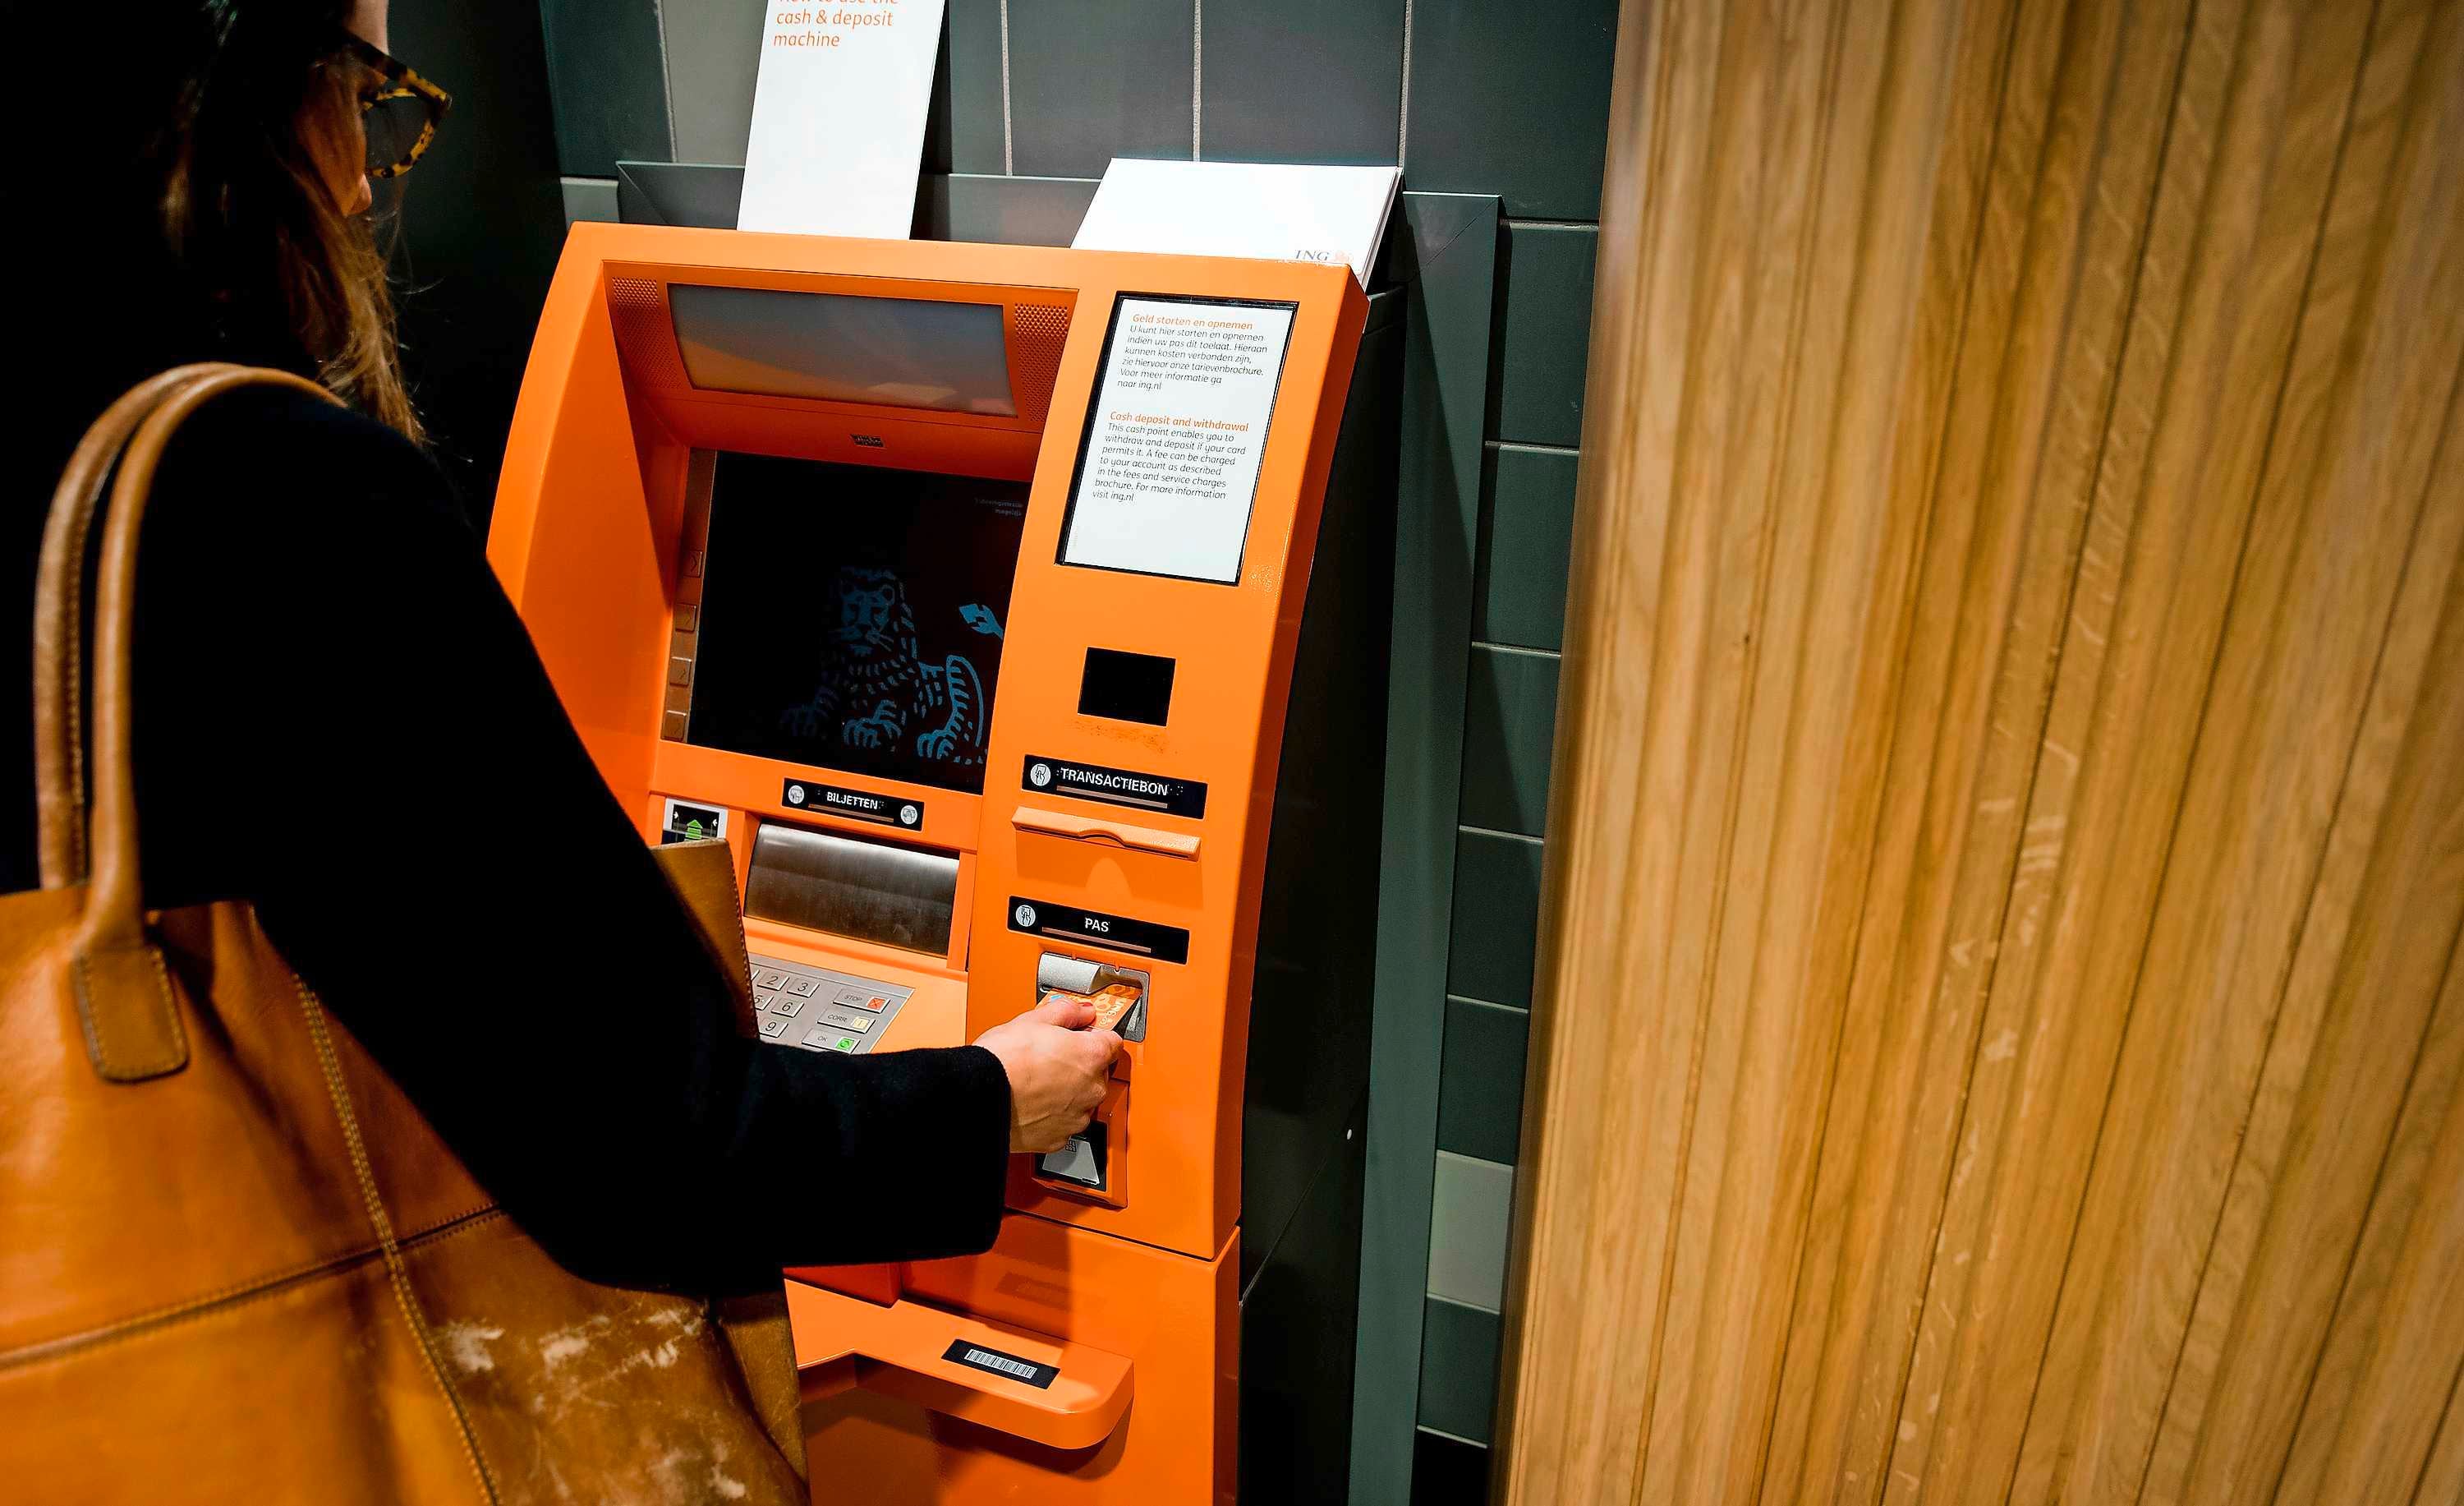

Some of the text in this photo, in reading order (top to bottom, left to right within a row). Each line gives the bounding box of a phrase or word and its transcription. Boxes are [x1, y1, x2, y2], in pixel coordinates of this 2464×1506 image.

[776, 9, 894, 30] cash & deposit
[774, 30, 840, 47] machine
[1295, 250, 1330, 261] ING
[1133, 314, 1155, 324] Geld
[1156, 316, 1191, 325] storten
[1207, 320, 1253, 329] opnemen
[1130, 325, 1138, 333] U
[1138, 325, 1156, 334] kunt
[1159, 327, 1175, 335] hier
[1177, 329, 1207, 338] storten
[1223, 333, 1264, 342] opnemen
[1186, 339, 1198, 348] dit
[1199, 342, 1232, 351] toelaat.
[1234, 343, 1268, 353] Hieraan
[1122, 357, 1133, 366] zie
[1135, 357, 1168, 367] hiervoor
[1124, 346, 1252, 365] kunnen kosten verbonden zijn,
[1119, 368, 1139, 377] Voor
[1165, 371, 1209, 382] informatie
[1211, 377, 1222, 385] ga
[1138, 381, 1162, 391] ing.nl
[1110, 411, 1249, 432] Cash deposit and withdrawal
[1108, 422, 1234, 443] This cash point enables you to
[1105, 435, 1247, 454] withdraw and deposit if your card
[1101, 446, 1134, 456] permits
[1146, 449, 1152, 458] A
[1154, 449, 1168, 458] fee
[1188, 453, 1198, 462] be
[1200, 454, 1236, 467] charged
[1110, 458, 1131, 467] your
[1132, 460, 1165, 470] account
[1179, 463, 1222, 476] described
[1097, 467, 1227, 489] in the fees and service charges
[1092, 490, 1134, 503] visit ing.nl
[1095, 478, 1227, 499] brochure. For more information
[1060, 767, 1168, 796] TRANSACTIEBON
[826, 791, 878, 809] BILJETTEN
[1085, 917, 1110, 933] PAS
[766, 975, 808, 992] 2 3
[755, 994, 793, 1011] 5 6
[844, 993, 863, 1002] STOP
[765, 1021, 777, 1032] 9
